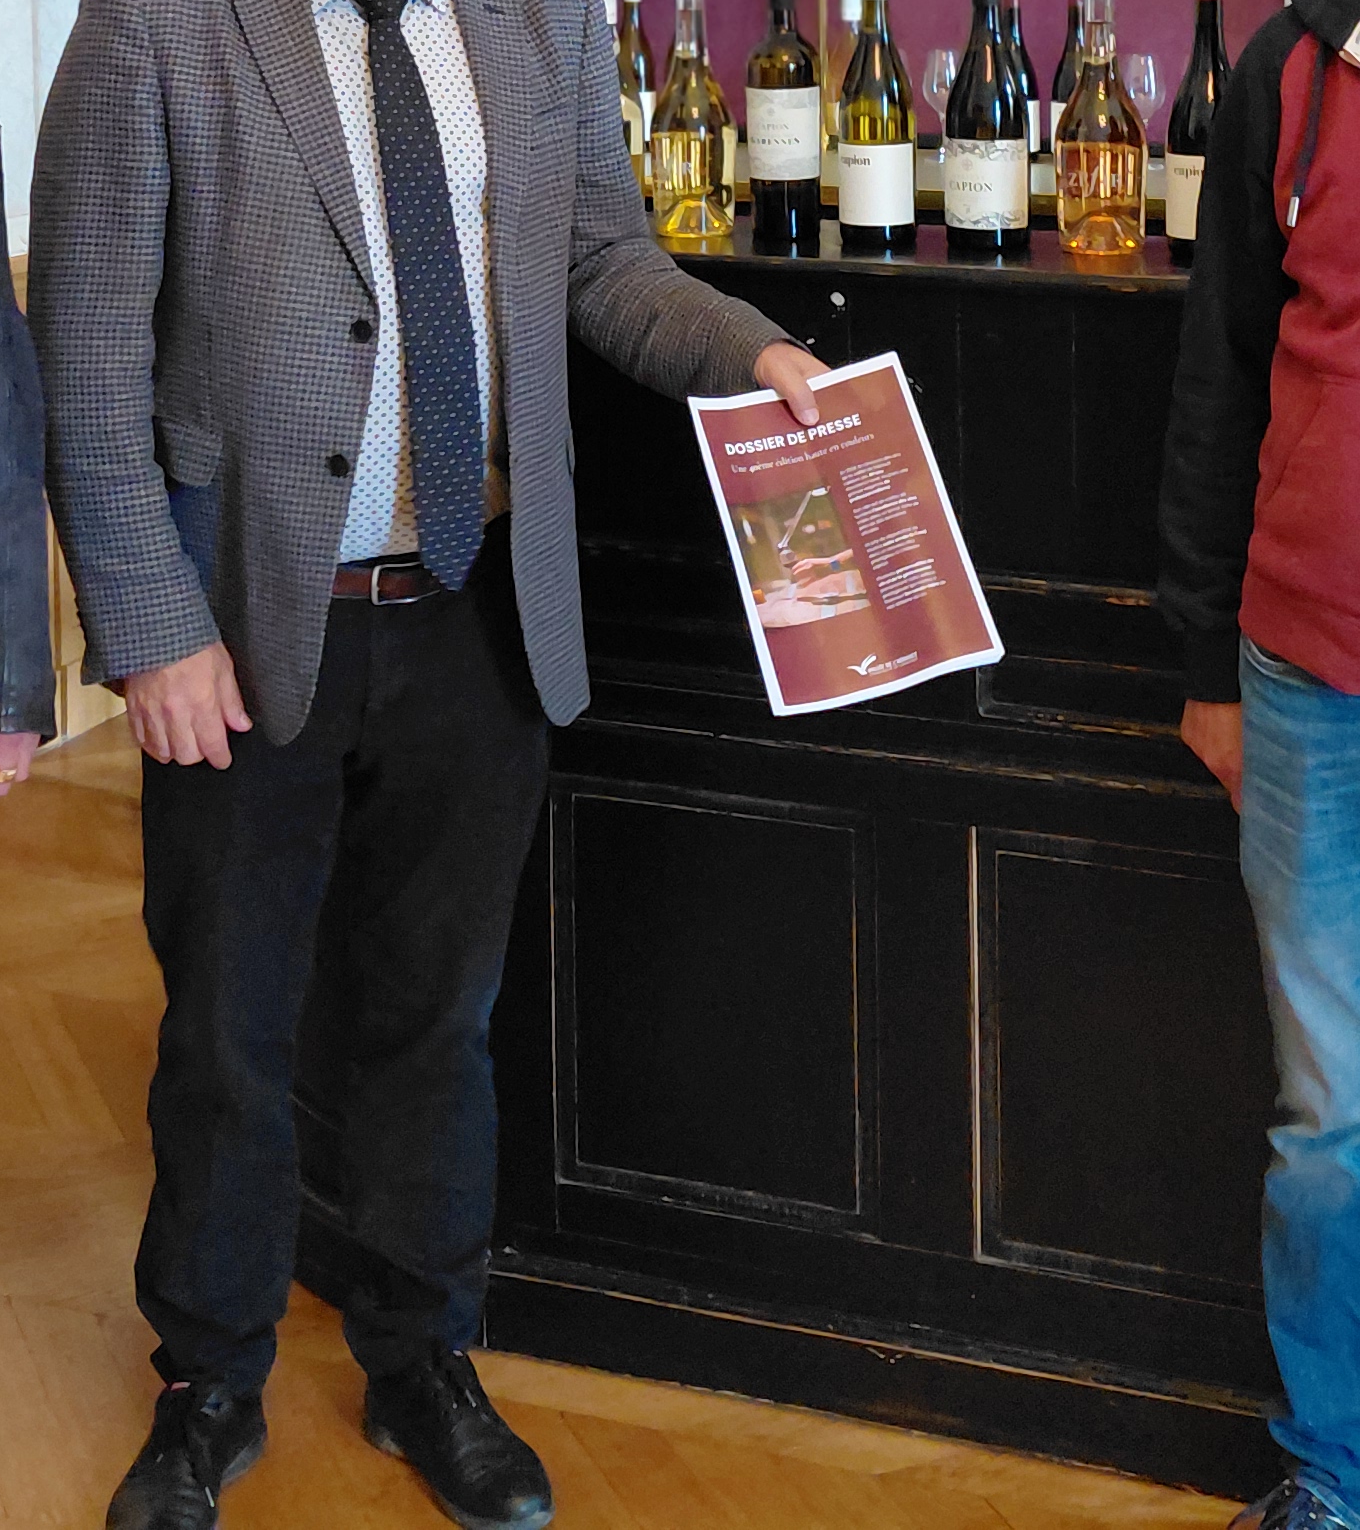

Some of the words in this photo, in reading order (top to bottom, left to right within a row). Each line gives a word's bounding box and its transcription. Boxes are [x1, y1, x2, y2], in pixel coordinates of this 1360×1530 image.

[949, 180, 993, 192] CAPION
[725, 435, 785, 455] DOSSIER
[787, 431, 807, 445] DE
[808, 413, 862, 440] PRESSE
